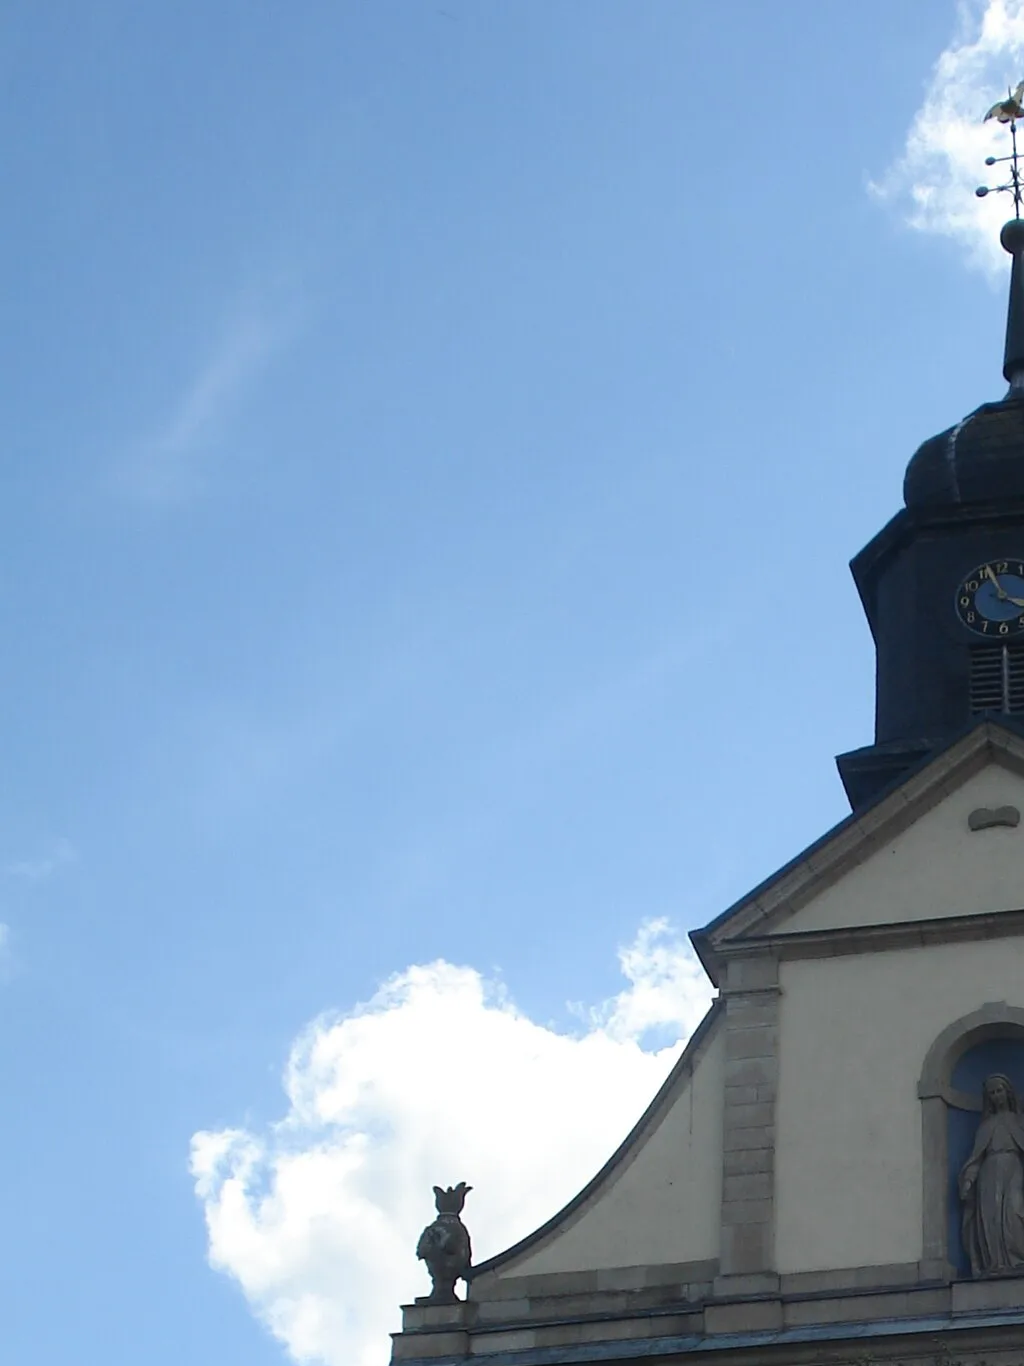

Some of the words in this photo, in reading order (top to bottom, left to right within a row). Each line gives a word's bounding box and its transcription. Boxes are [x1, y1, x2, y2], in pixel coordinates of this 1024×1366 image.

[996, 562, 1008, 573] 12
[965, 581, 978, 592] 10
[960, 596, 969, 608] 9
[967, 611, 975, 623] 8
[982, 621, 989, 633] 7
[999, 622, 1008, 634] 6
